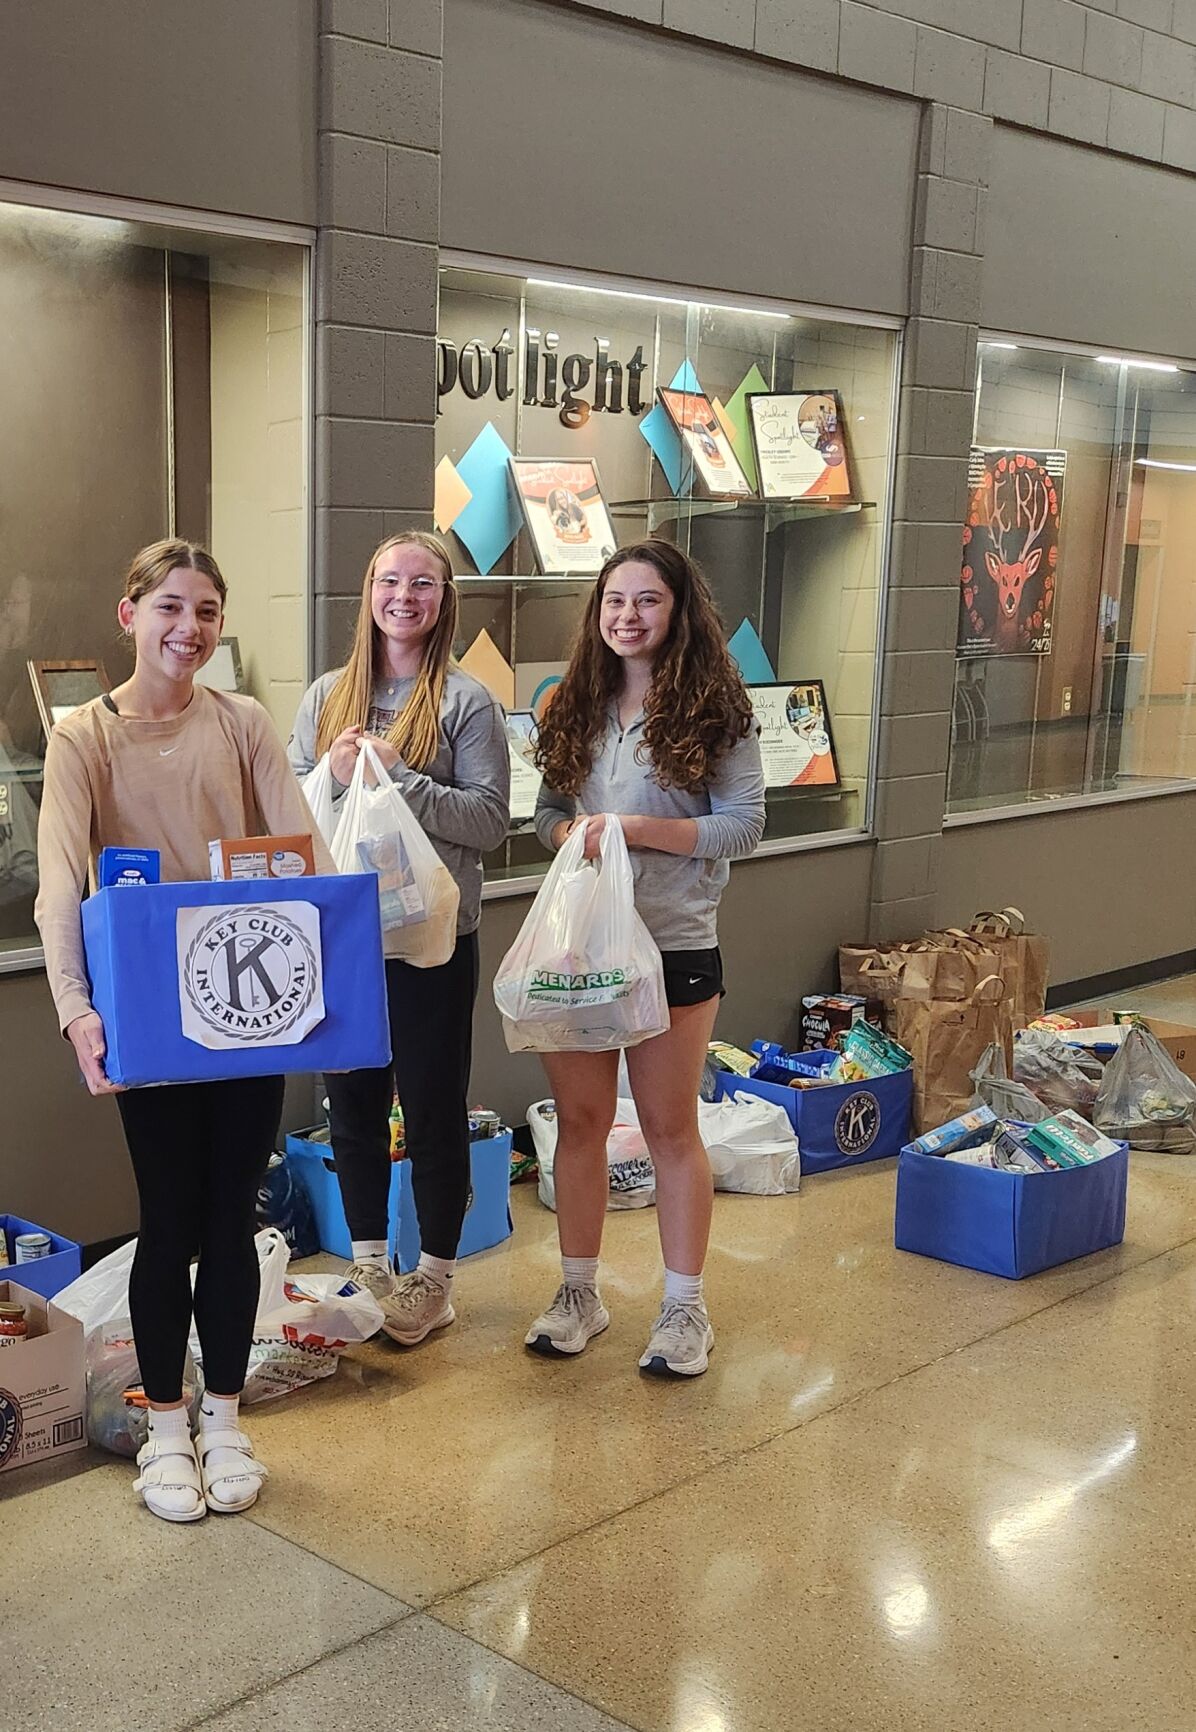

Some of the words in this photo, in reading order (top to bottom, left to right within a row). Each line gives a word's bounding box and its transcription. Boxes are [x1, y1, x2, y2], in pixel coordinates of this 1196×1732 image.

[437, 327, 648, 429] potlight
[761, 420, 800, 445] Spotlight
[205, 921, 238, 952] KEY
[249, 919, 294, 947] CLUB
[531, 968, 625, 990] MENARDS
[197, 962, 305, 1029] INTERNATIONAL
[527, 992, 561, 1002] Dedicated
[570, 996, 598, 1005] Service
[802, 1015, 830, 1032] CHOCULA
[845, 1099, 857, 1114] KEY
[860, 1098, 874, 1111] CLUB
[840, 1117, 876, 1148] INTERNATIONAL
[19, 1388, 47, 1400] everyday
[24, 1429, 45, 1439] Sheets
